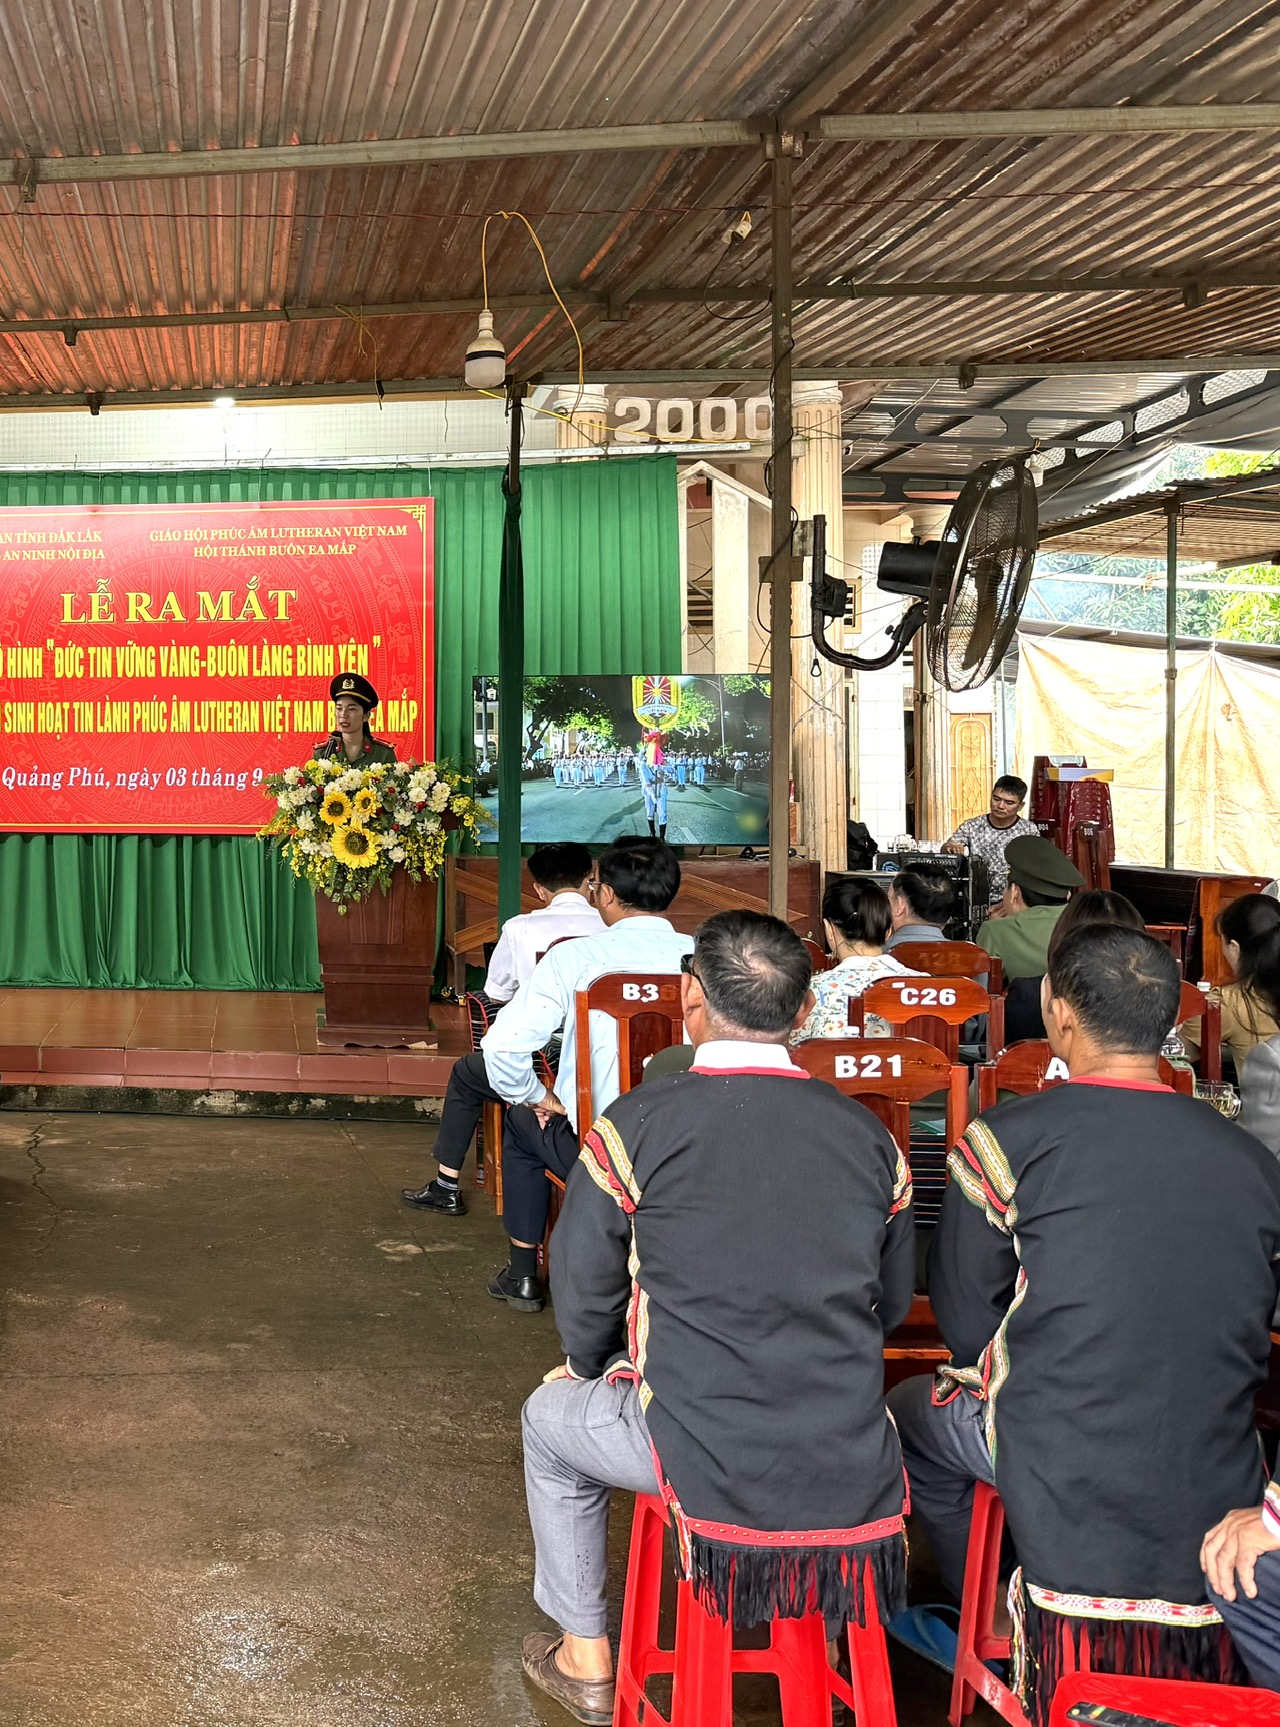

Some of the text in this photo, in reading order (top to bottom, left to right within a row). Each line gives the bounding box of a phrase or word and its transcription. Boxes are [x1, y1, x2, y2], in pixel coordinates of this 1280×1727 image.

[614, 397, 772, 443] 2000
[49, 527, 75, 543] ĐẮK
[149, 523, 408, 543] GIÁO HỘI PHÚC ÂM LUTHERAN VIỆT NAM
[3, 550, 20, 561] AN
[22, 549, 56, 560] NINH
[58, 546, 80, 561] NỘI
[83, 548, 106, 561] ĐỊA
[193, 544, 218, 560] HỘI
[220, 543, 267, 557] THÁNH
[269, 542, 306, 556] BUÔN
[308, 544, 326, 555] EA
[60, 575, 298, 624] LỄ RA MẮT
[7, 641, 43, 678] HÌNH
[87, 646, 113, 678] TIN
[115, 640, 156, 678] VỮNG
[252, 638, 293, 677] LÀNG
[296, 638, 334, 677] BÌNH
[337, 637, 369, 676] YÊN
[4, 701, 35, 733] SINH
[37, 702, 70, 740] HOẠT
[72, 701, 93, 733] TIN
[96, 694, 130, 733] LÀNH
[133, 694, 167, 733] PHÚC
[170, 694, 191, 733] ÂM
[193, 701, 260, 733] LUTHERAN
[262, 693, 291, 740] VIỆT
[293, 700, 324, 733] NAM
[387, 688, 418, 732] MẮP
[1, 765, 64, 791] Quảng
[67, 767, 111, 790] Phú,
[115, 767, 162, 791] ngày
[165, 767, 187, 787] 03
[191, 767, 248, 791] tháng
[251, 767, 263, 787] 9
[900, 987, 957, 1006] C26
[835, 1054, 902, 1079] B21
